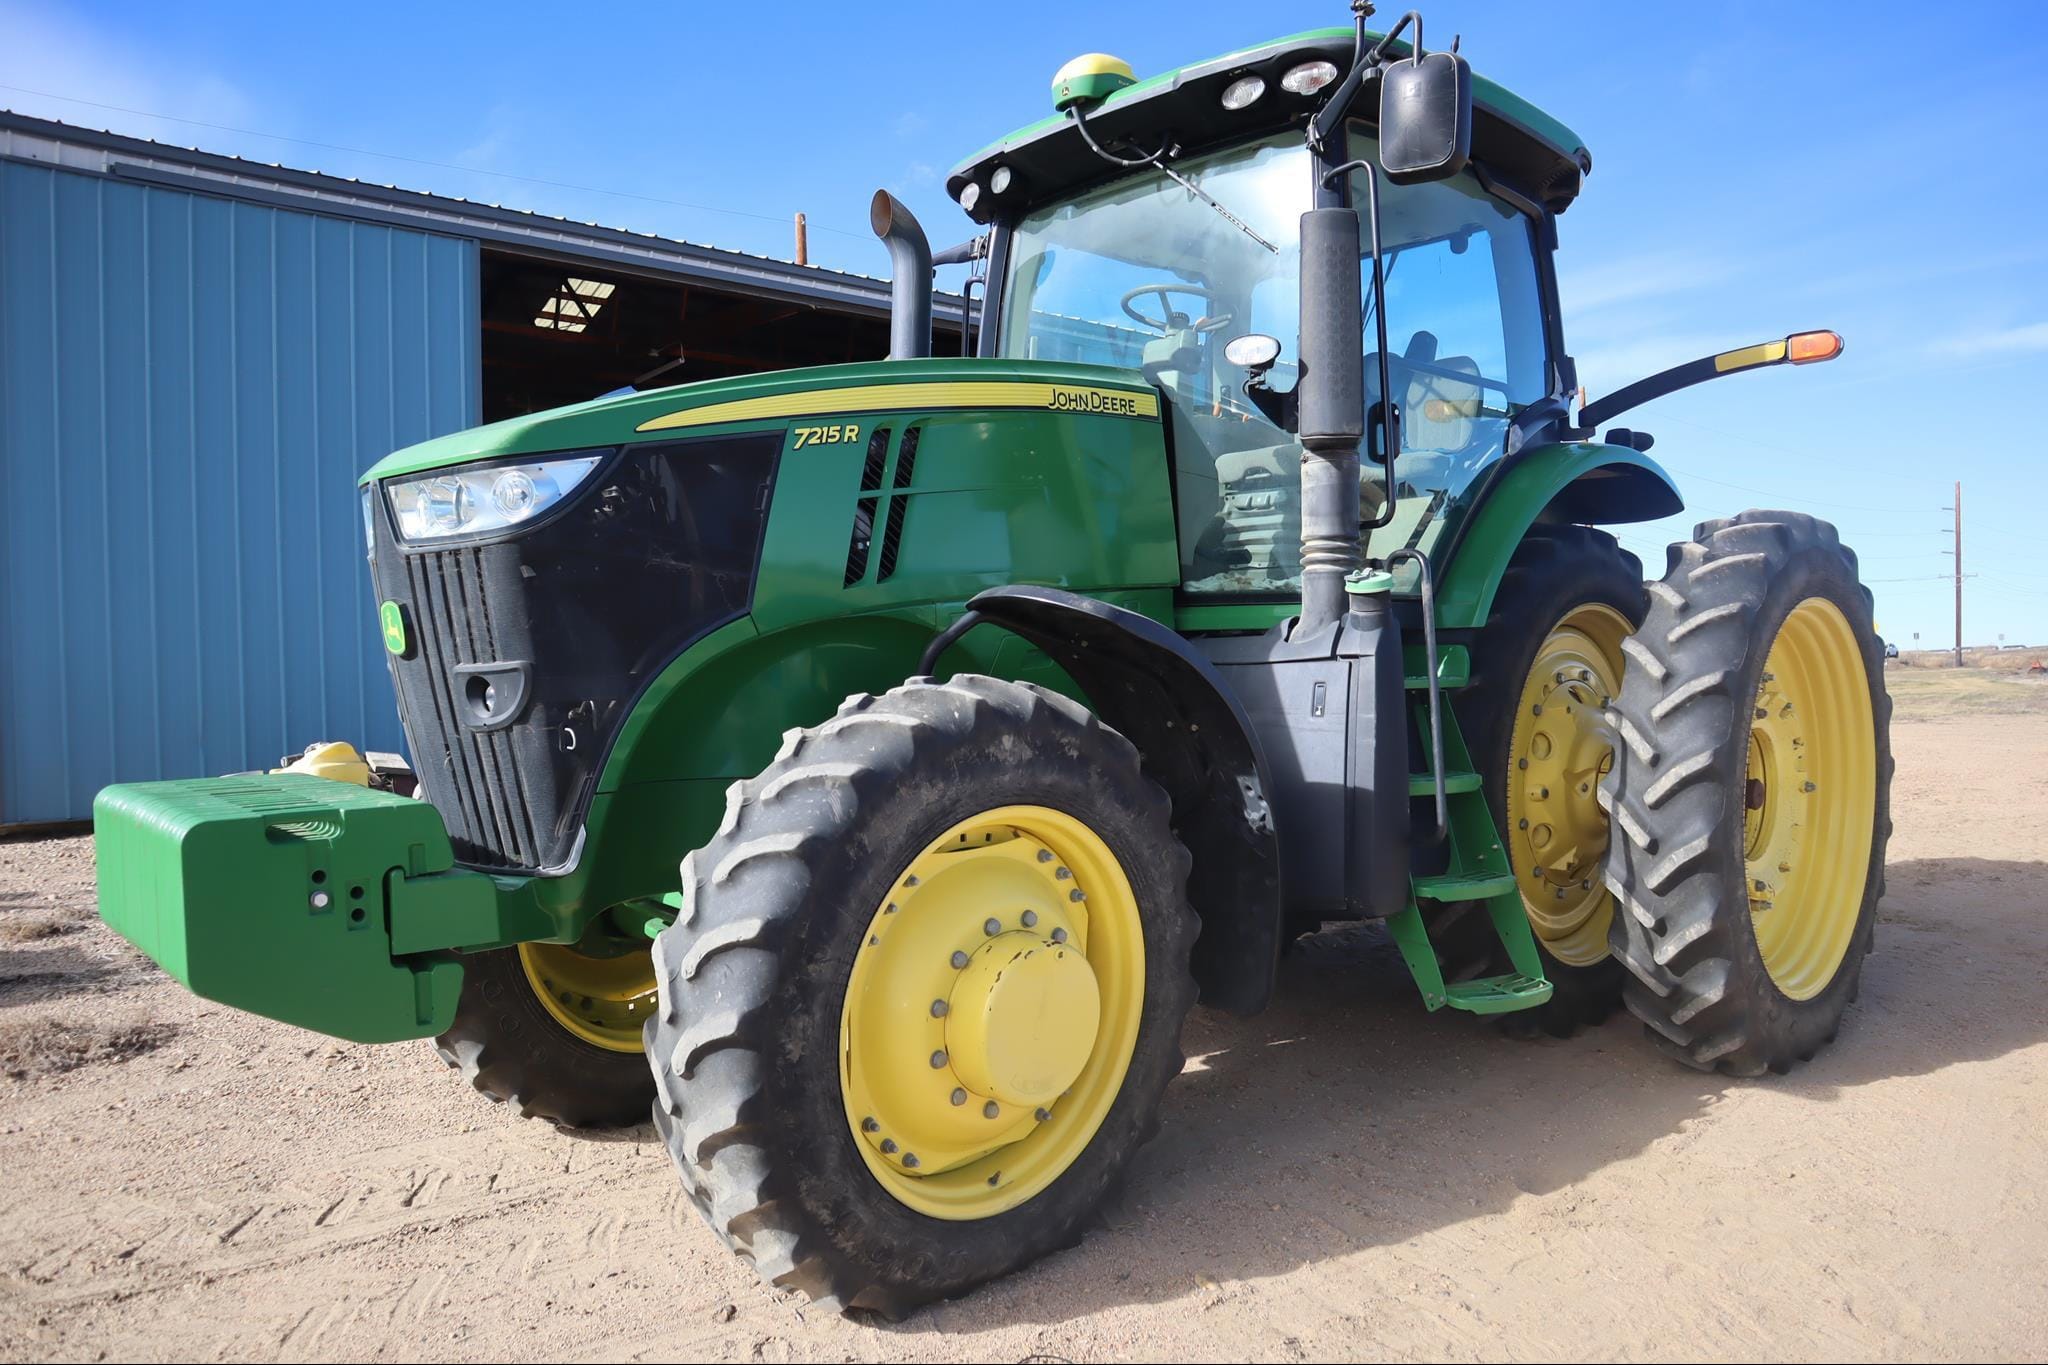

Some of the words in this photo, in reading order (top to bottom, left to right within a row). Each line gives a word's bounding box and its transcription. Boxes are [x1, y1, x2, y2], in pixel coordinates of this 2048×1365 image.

[1048, 388, 1089, 409] JOHN
[1090, 391, 1136, 413] DEERE
[793, 425, 842, 450] 7215
[843, 424, 860, 443] R
